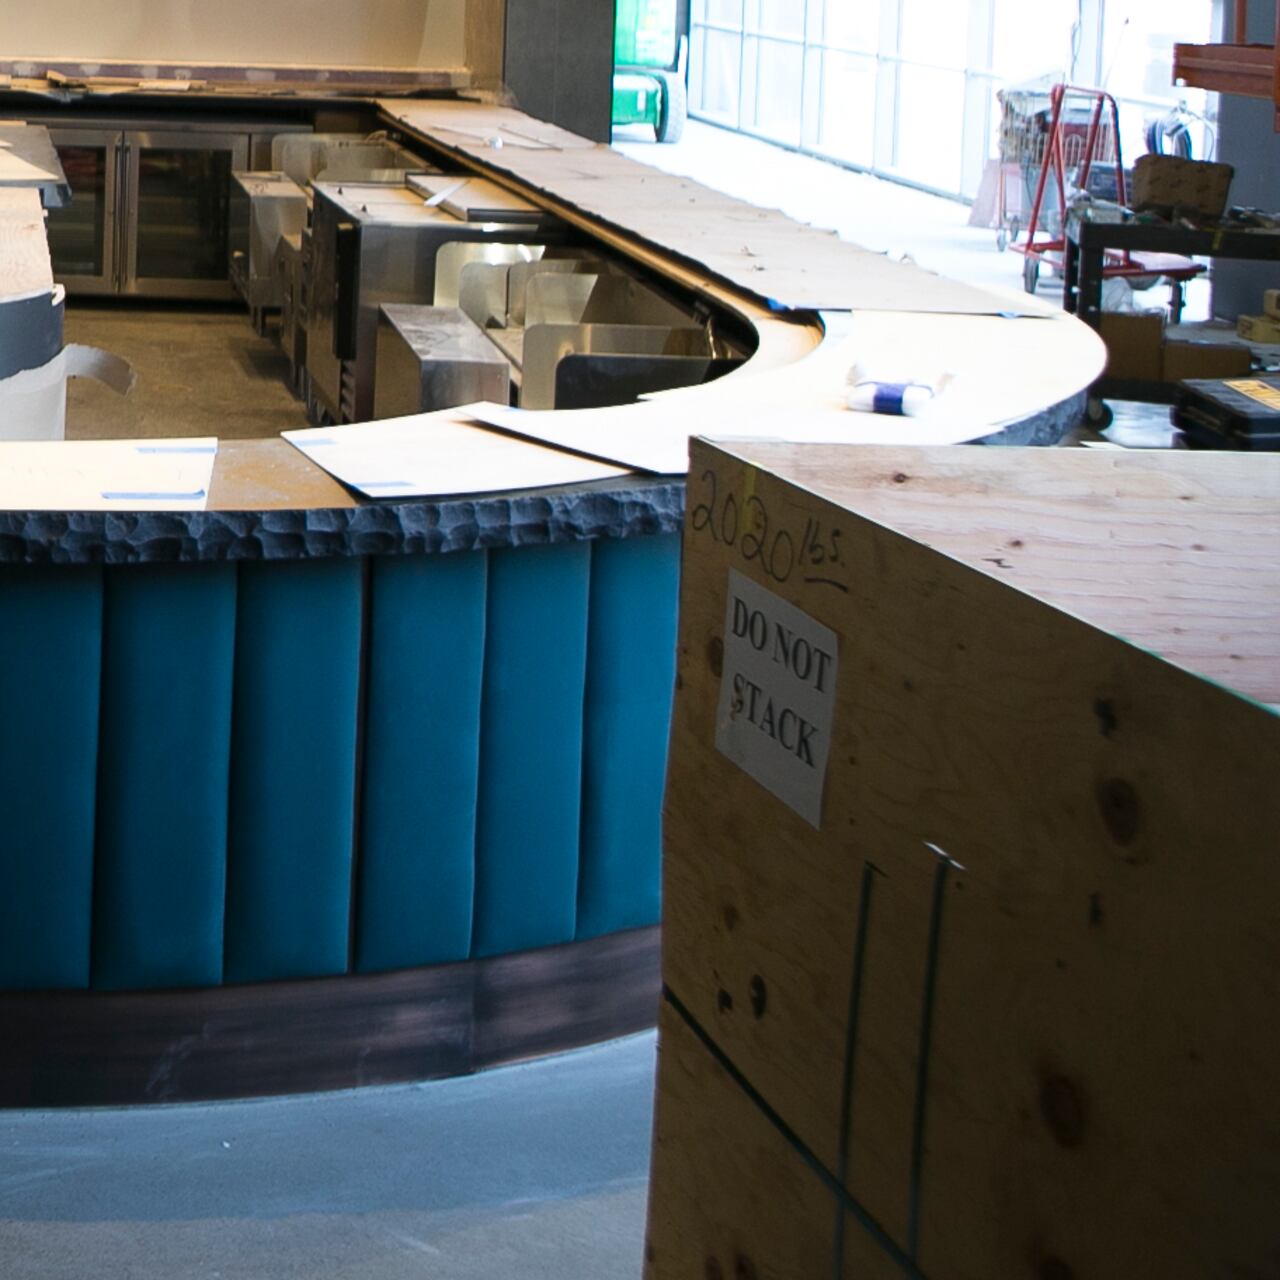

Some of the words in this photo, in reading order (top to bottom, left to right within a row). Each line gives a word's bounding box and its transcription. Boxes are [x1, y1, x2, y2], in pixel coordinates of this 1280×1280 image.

[692, 470, 794, 582] 2020
[732, 596, 767, 651] DO
[772, 623, 832, 693] NOT
[733, 673, 819, 768] STACK
